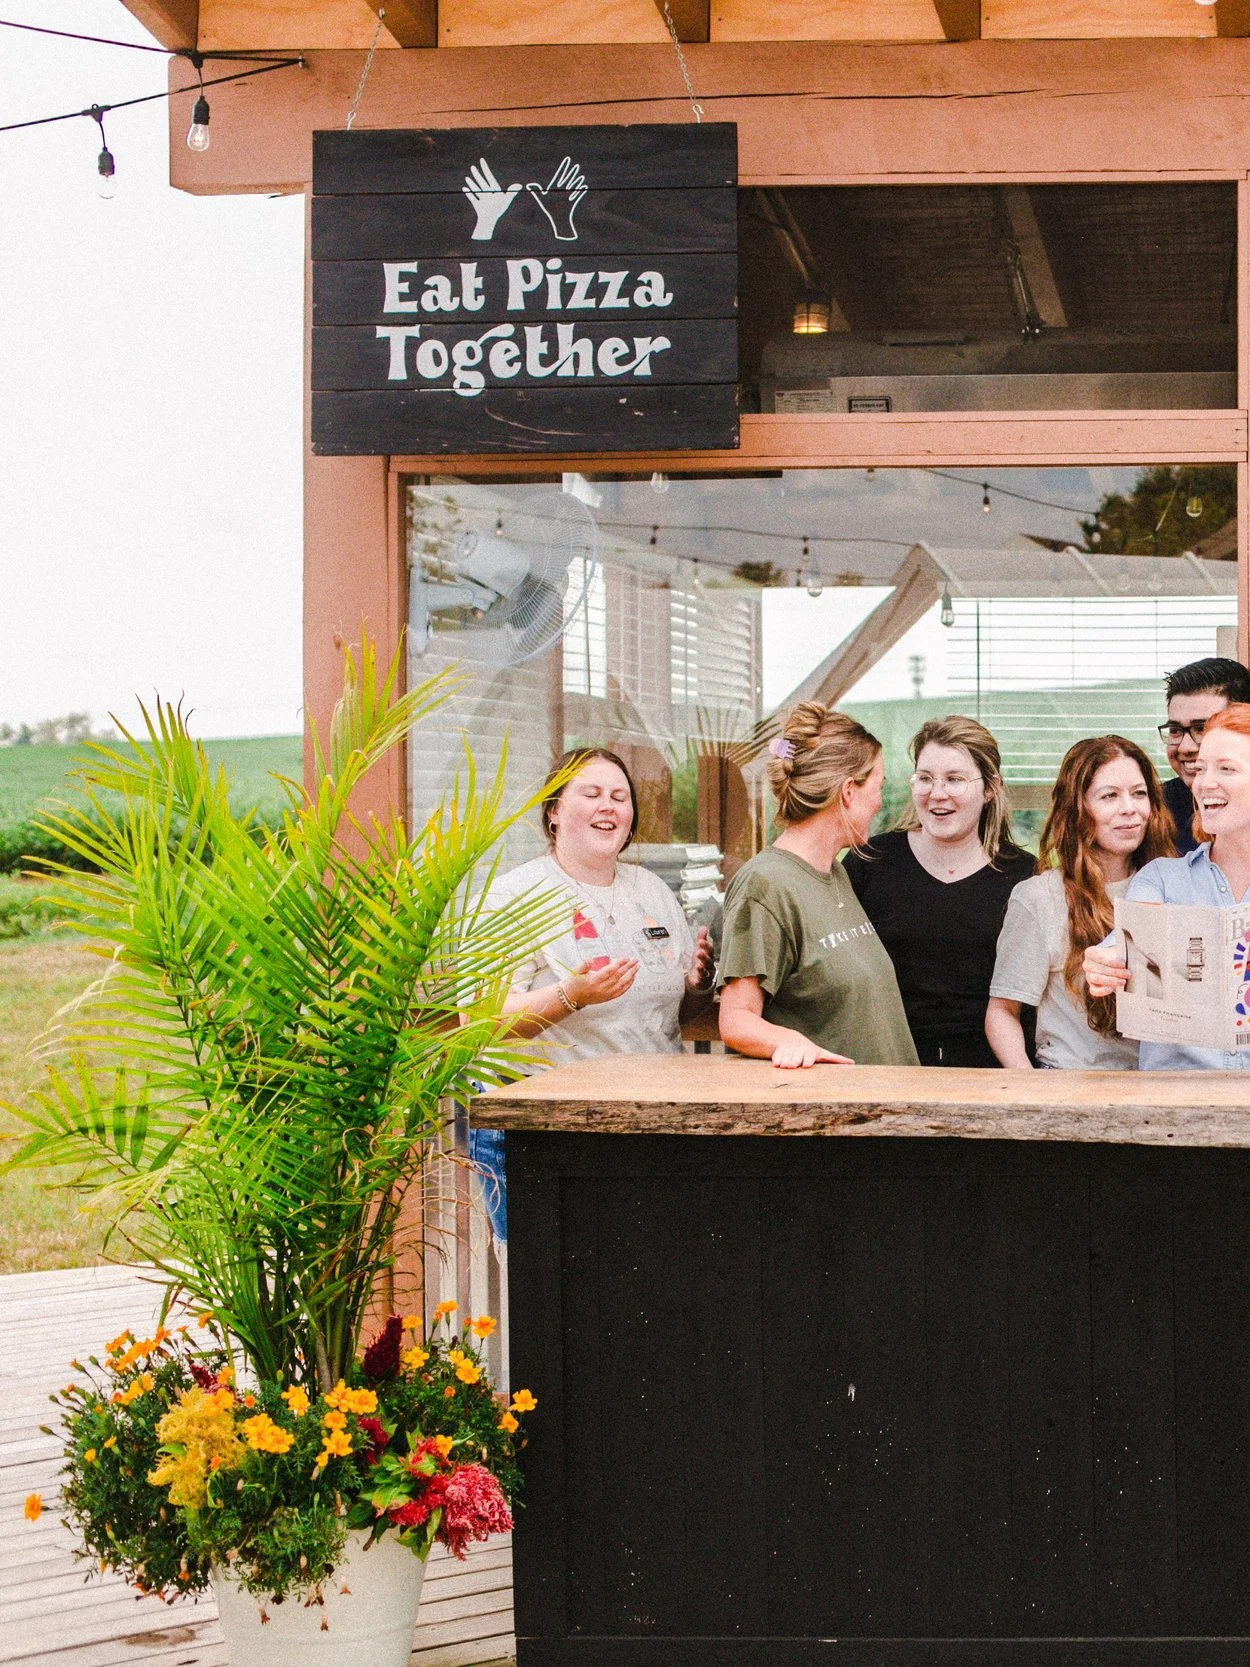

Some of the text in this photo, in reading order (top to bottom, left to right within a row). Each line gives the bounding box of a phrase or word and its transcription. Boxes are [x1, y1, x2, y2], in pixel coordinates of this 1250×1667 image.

[382, 257, 674, 314] Eat Pizza
[375, 322, 672, 397] Together
